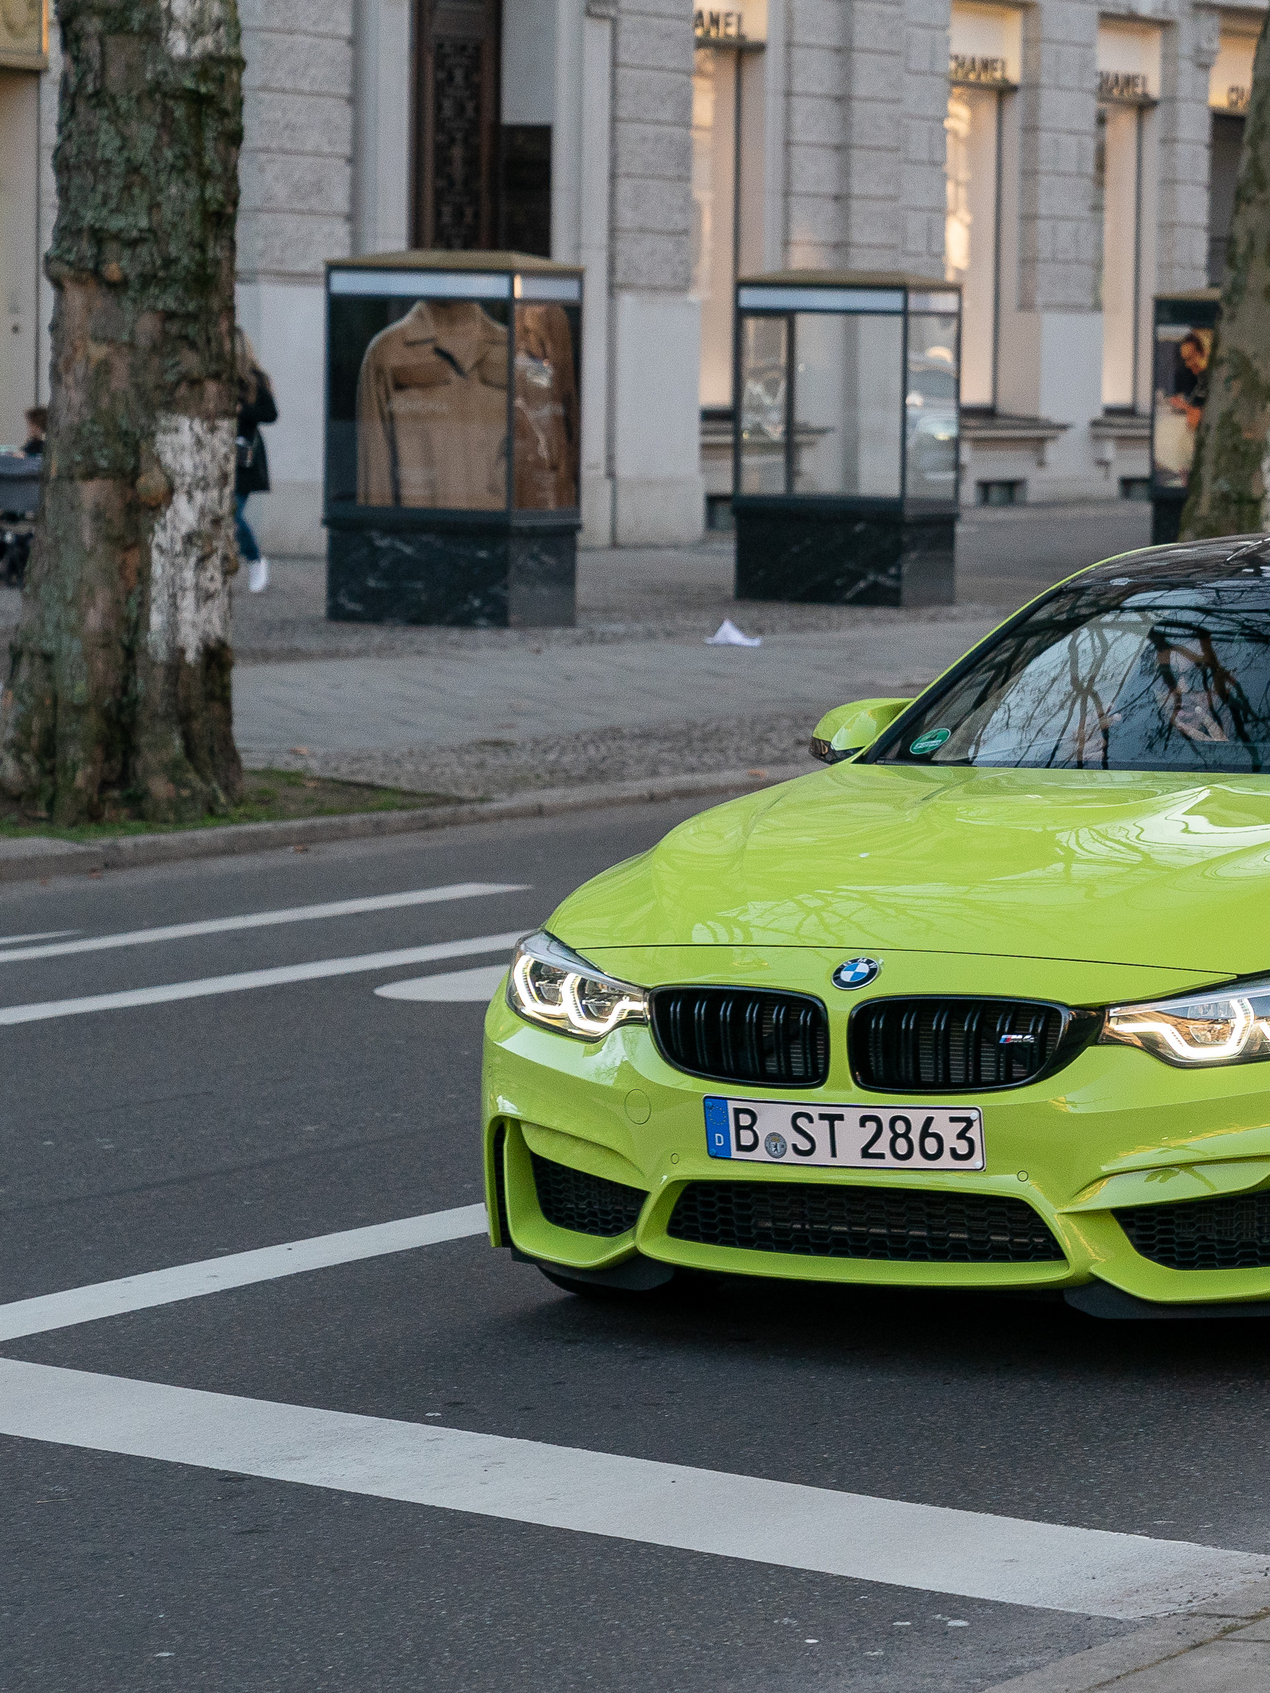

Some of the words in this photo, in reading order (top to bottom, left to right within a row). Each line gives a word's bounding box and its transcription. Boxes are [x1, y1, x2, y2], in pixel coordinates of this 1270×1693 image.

[715, 1133, 724, 1146] D
[732, 1107, 760, 1153] B
[791, 1111, 845, 1158] ST
[859, 1114, 976, 1162] 2863
